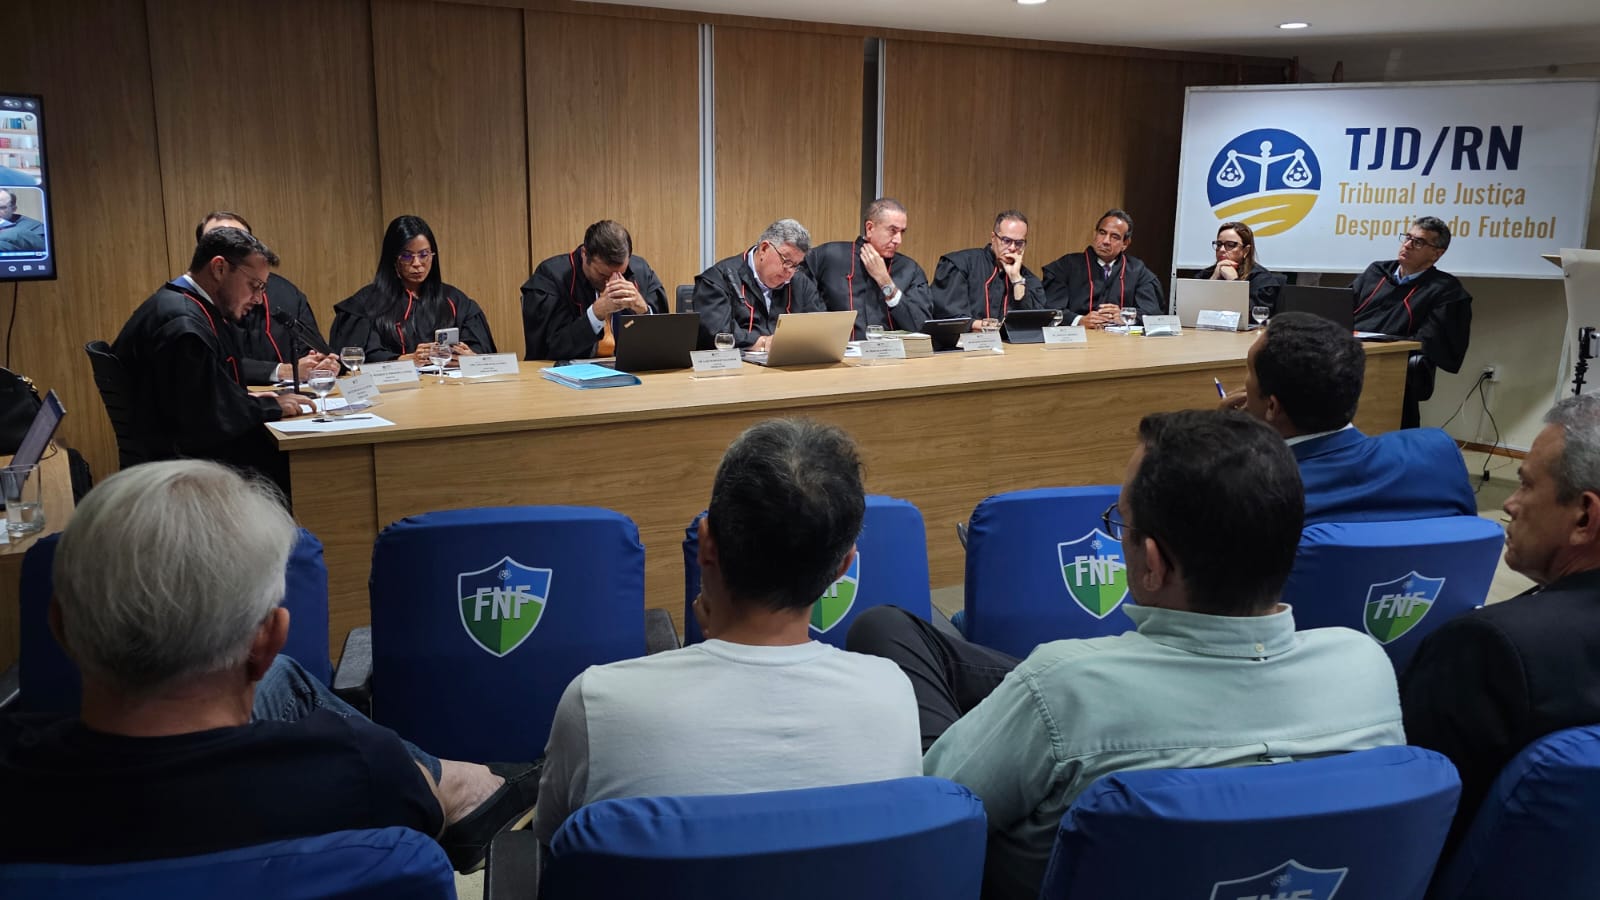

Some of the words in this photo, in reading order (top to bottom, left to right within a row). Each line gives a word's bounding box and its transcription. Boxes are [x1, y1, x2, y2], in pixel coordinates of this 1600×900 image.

[1345, 125, 1523, 176] TJD/RN
[1338, 182, 1416, 204] Tribunal
[1423, 182, 1446, 204] de
[1453, 182, 1526, 208] Justiça
[1335, 213, 1417, 240] Desport
[1448, 215, 1470, 237] do
[1478, 216, 1557, 239] Futebol
[1074, 554, 1120, 586] FNF
[473, 585, 531, 622] FNF
[1373, 591, 1426, 620] FNF
